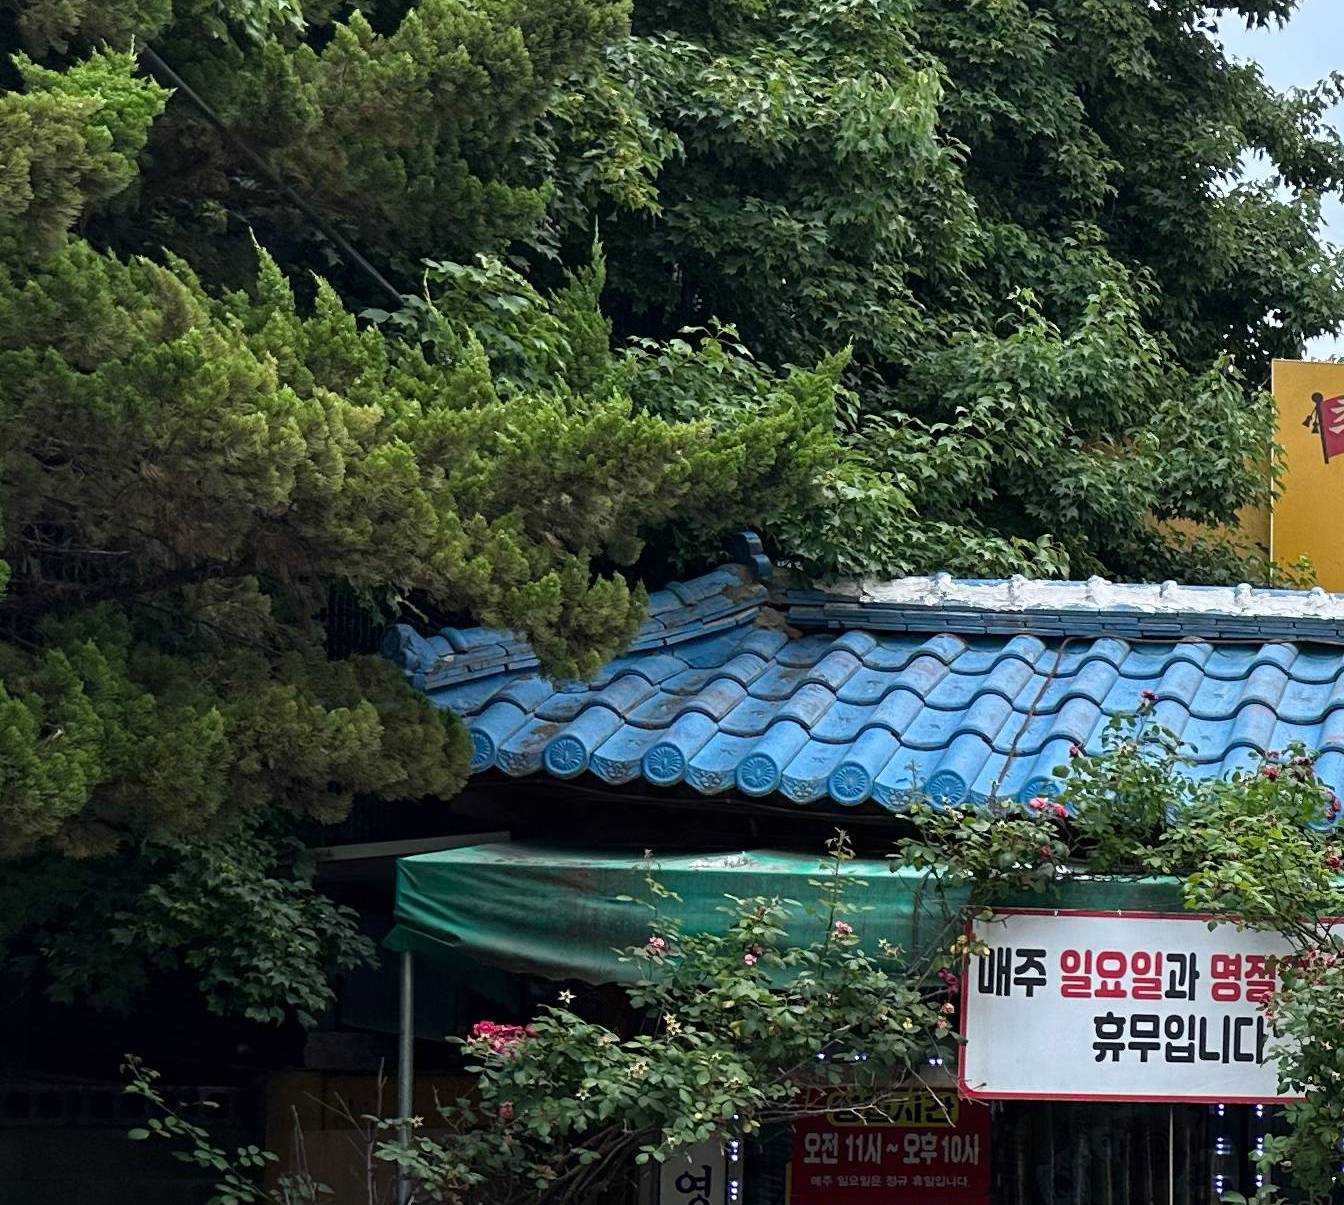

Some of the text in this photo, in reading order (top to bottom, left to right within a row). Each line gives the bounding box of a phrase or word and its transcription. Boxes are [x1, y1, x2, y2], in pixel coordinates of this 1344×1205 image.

[976, 946, 1047, 998] 매주
[1060, 949, 1200, 1001] 일요일과
[1092, 1011, 1266, 1064] 휴무입니다
[803, 1132, 839, 1165] 오전
[846, 1132, 882, 1165] 11시
[903, 1132, 938, 1165] 오후
[941, 1132, 980, 1165] 10시
